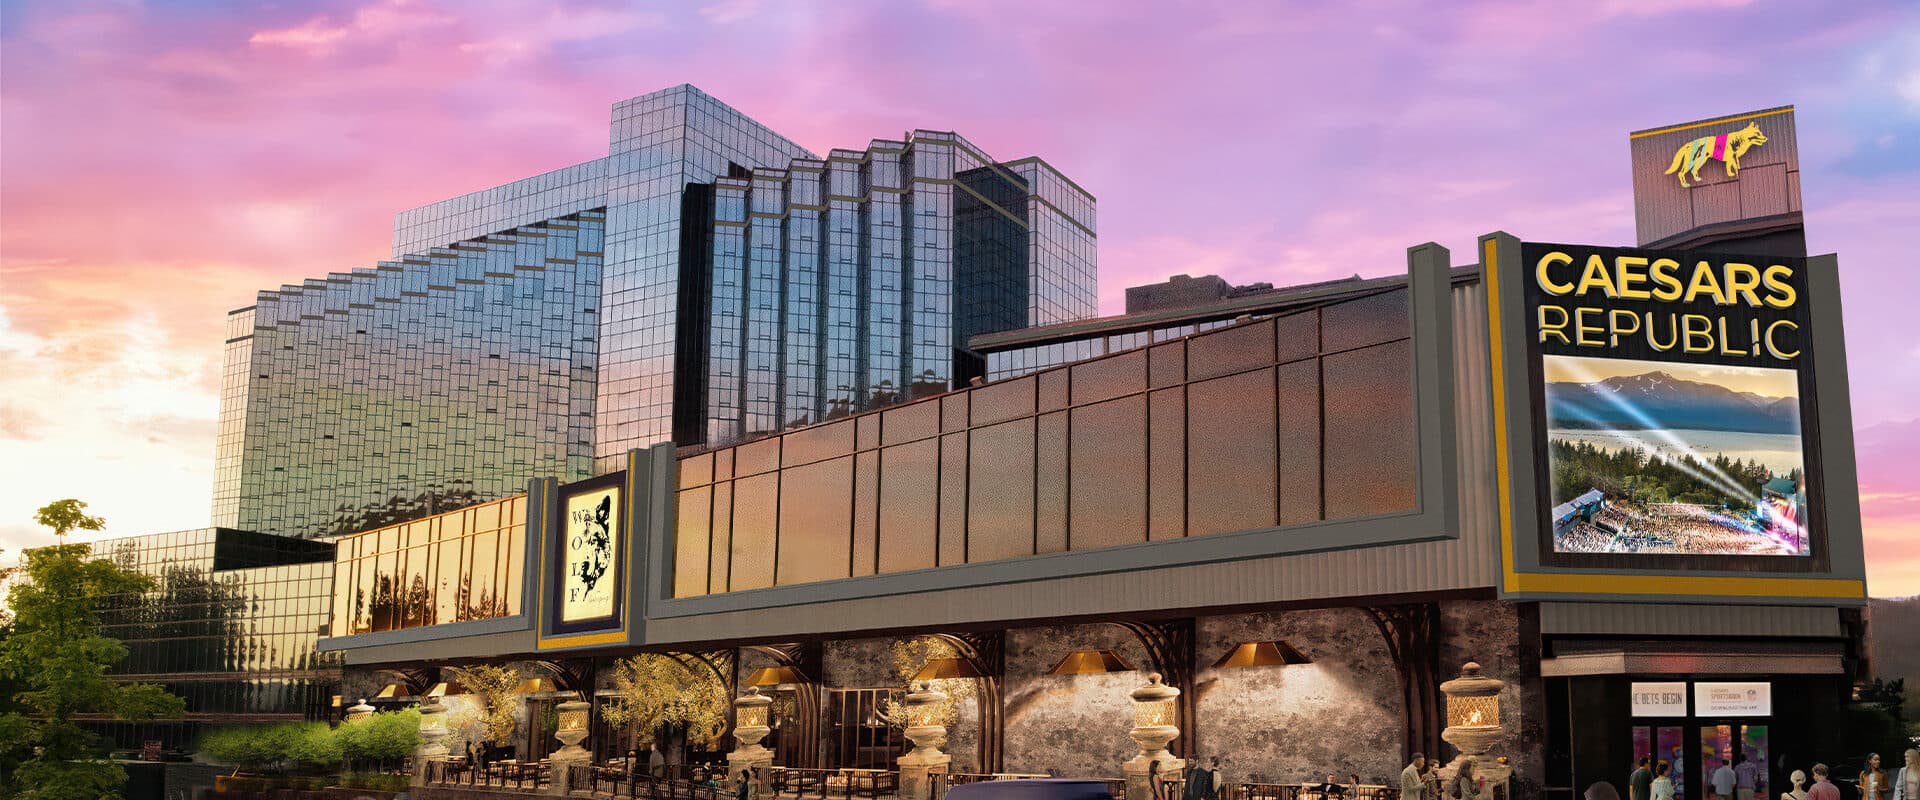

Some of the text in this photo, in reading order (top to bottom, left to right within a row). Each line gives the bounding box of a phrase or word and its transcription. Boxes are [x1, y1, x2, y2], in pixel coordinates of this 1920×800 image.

[1536, 251, 1797, 310] CAESARS
[1538, 304, 1800, 360] REPUBLIC
[570, 509, 584, 602] WOLF
[1641, 692, 1660, 704] BETS
[1662, 692, 1682, 704] BEGIN
